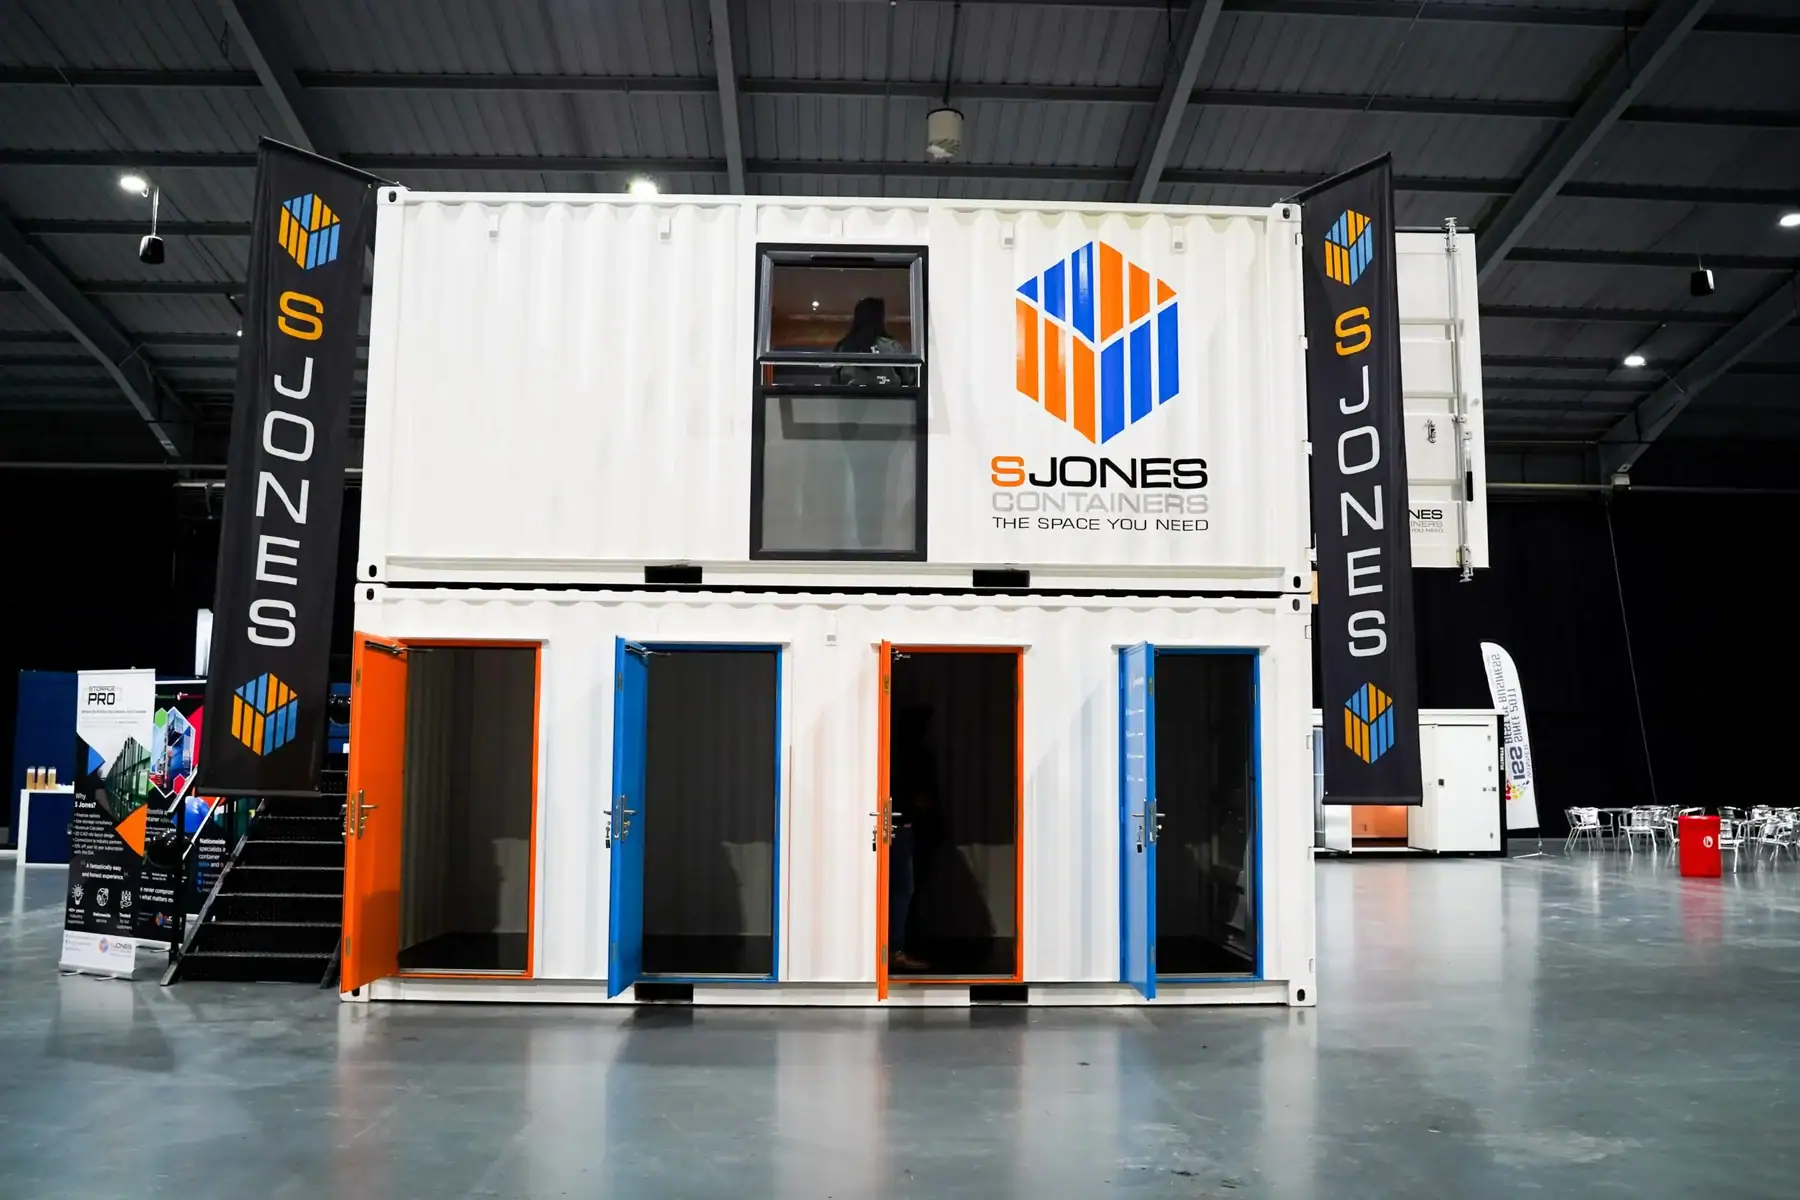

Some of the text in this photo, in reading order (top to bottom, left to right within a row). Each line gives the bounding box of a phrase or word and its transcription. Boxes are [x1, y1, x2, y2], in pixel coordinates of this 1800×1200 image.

[992, 491, 1209, 514] CONTAINERS
[1409, 509, 1443, 520] NES
[992, 516, 1209, 532] THE SPACE YOU NEED
[88, 692, 115, 705] PRO
